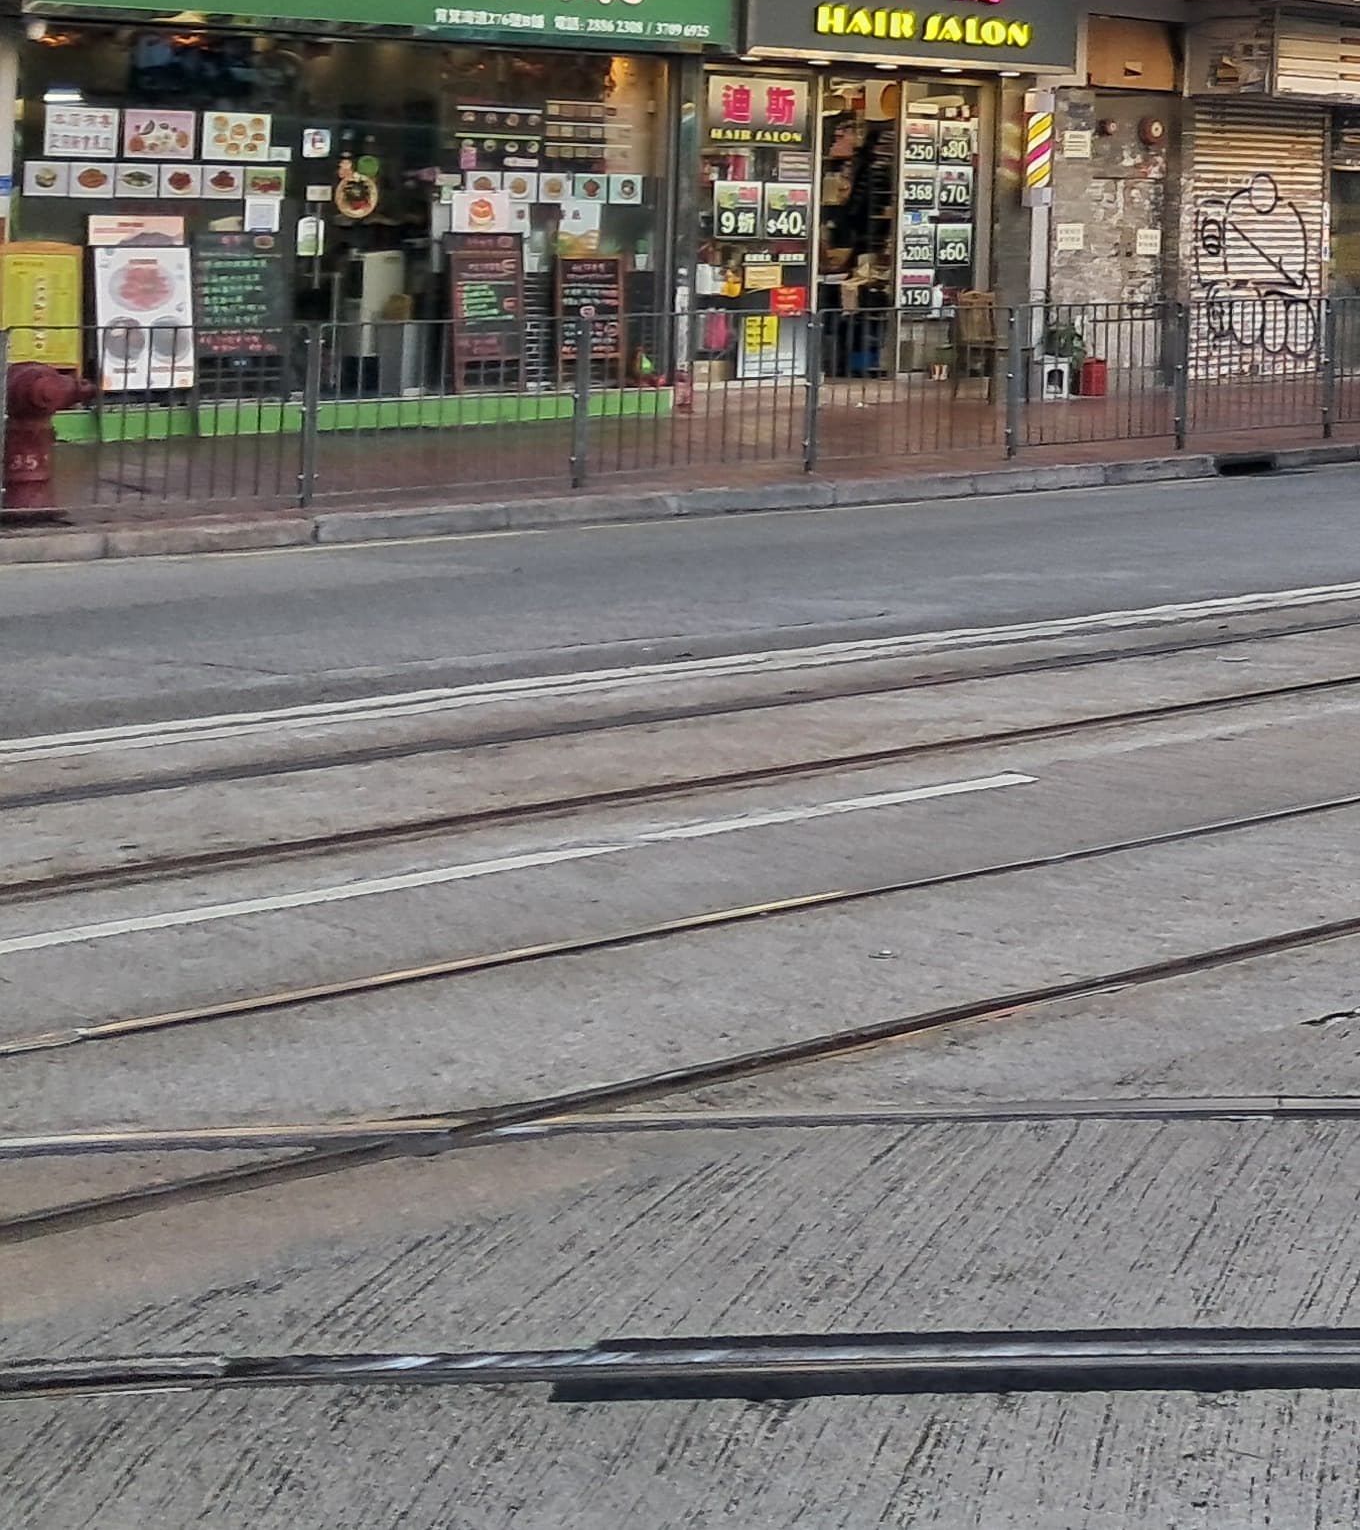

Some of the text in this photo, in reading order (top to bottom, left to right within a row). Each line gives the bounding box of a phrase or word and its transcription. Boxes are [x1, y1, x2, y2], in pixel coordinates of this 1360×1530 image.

[816, 3, 1031, 47] HAIR SALON
[722, 85, 796, 126] 迪斯
[710, 128, 803, 143] HAIR SALON
[940, 186, 966, 203] $70
[767, 211, 803, 234] $40
